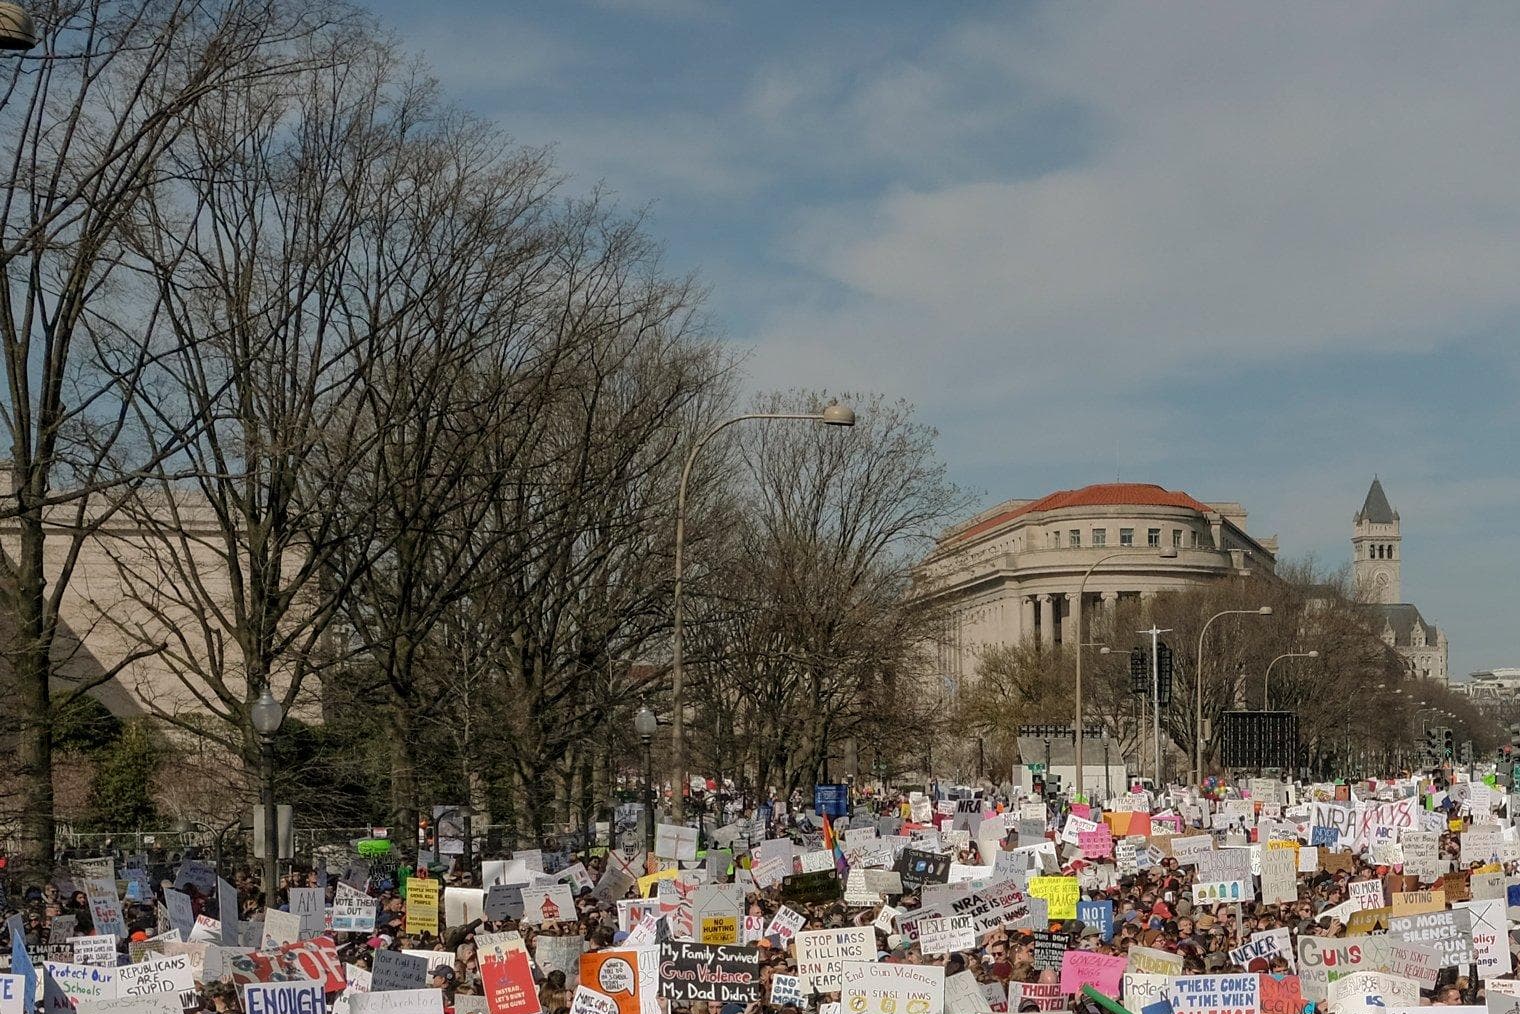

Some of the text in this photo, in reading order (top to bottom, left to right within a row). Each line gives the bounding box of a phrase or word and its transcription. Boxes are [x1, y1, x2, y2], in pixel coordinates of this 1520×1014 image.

[958, 800, 980, 814] NRA
[1374, 826, 1392, 837] ABC
[1350, 884, 1380, 896] NO MORE
[1404, 892, 1432, 904] VOTING
[1082, 907, 1106, 920] NOT
[703, 925, 734, 933] HUNTING
[804, 932, 865, 946] STOP MASS
[661, 942, 759, 964] My Family Survived
[806, 945, 862, 959] KILLINGS
[1231, 936, 1275, 964] NEVER
[49, 965, 112, 983] Protect Our
[660, 962, 751, 984] Gun Violence
[801, 965, 822, 974] BAN
[1175, 977, 1256, 993] THERE COMES
